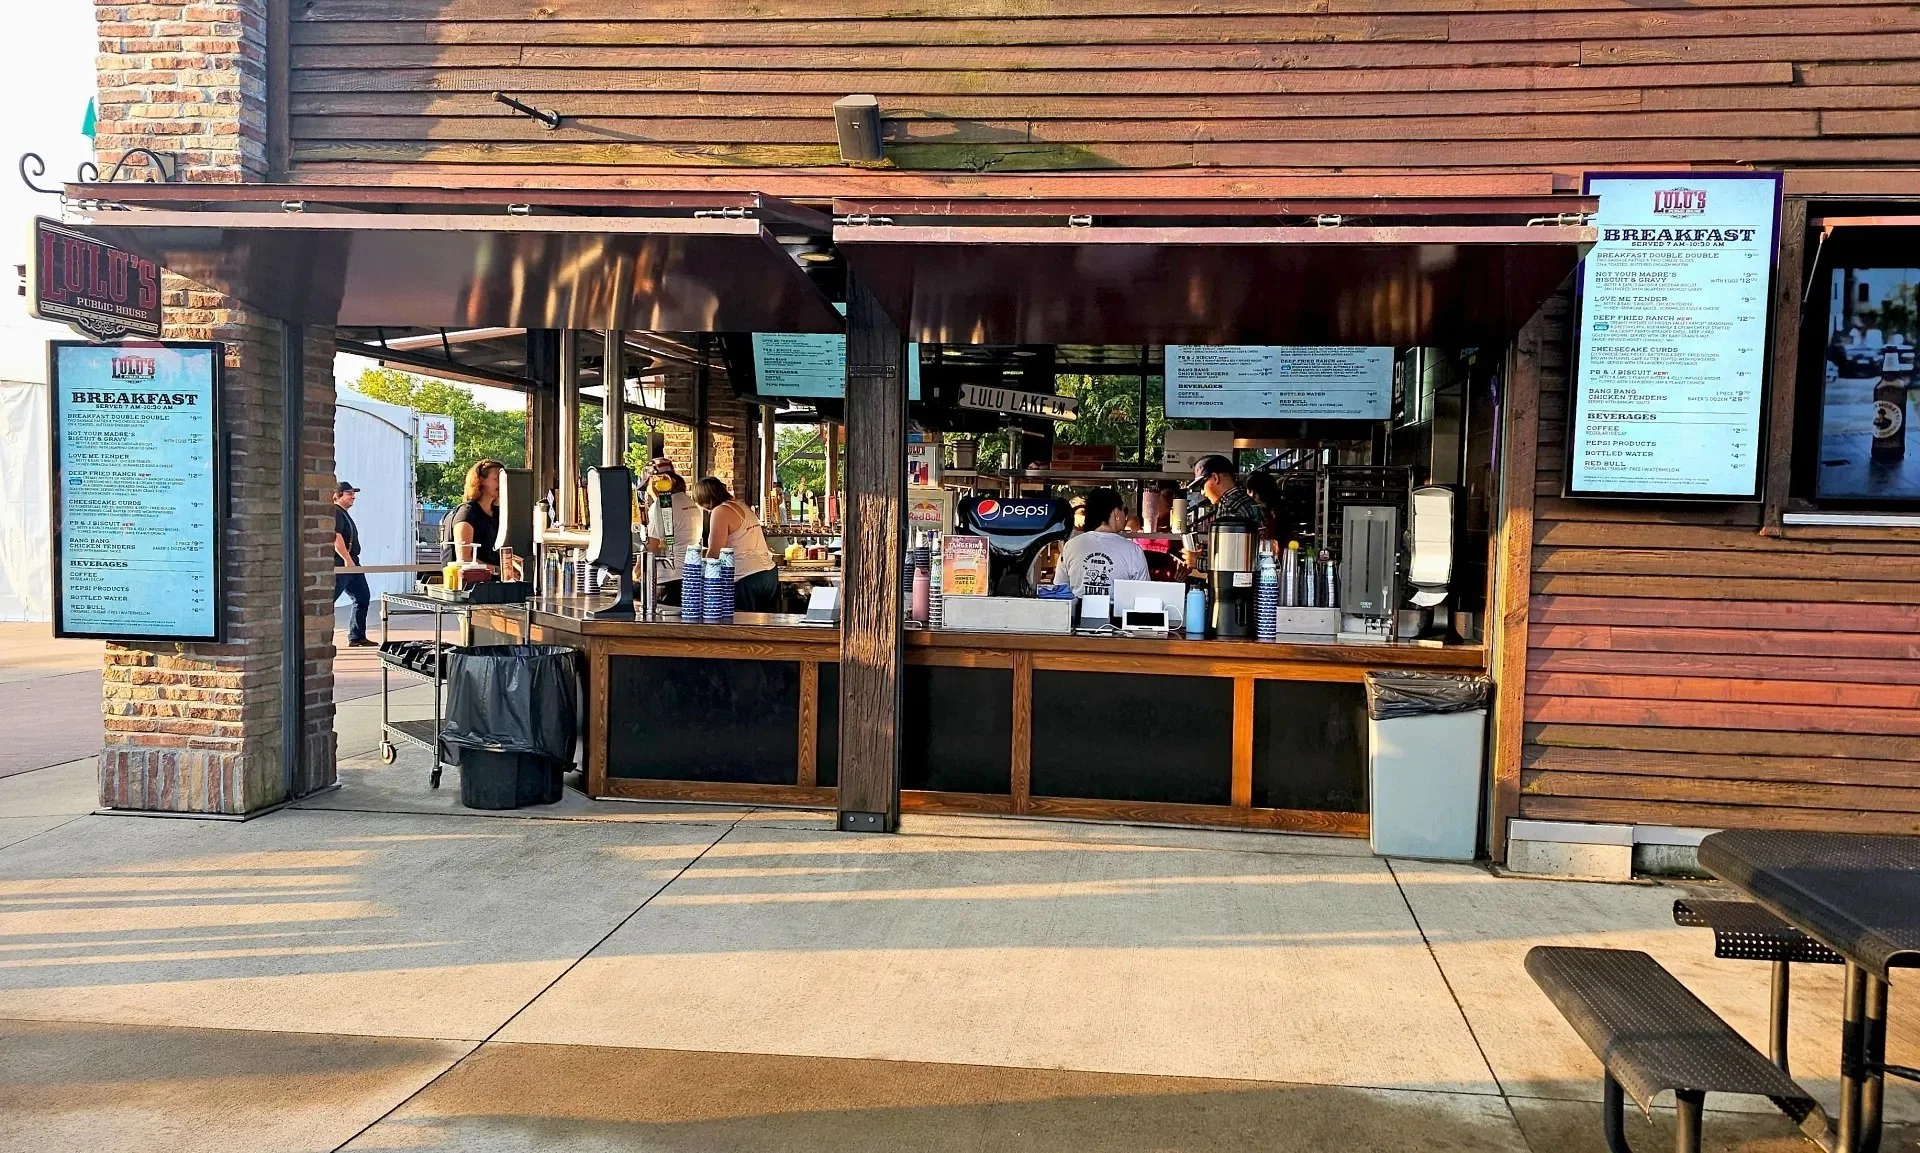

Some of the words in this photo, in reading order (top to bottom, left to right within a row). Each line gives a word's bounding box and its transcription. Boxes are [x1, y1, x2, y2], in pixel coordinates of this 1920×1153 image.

[1654, 190, 1706, 213] LULU'S
[1604, 229, 1755, 242] BREAKFAST
[42, 232, 156, 309] LULU'S
[77, 297, 113, 312] PUBLIC
[116, 306, 147, 318] HOUSE
[112, 358, 155, 378] LULU'S
[72, 392, 198, 405] BREAKFAST
[970, 388, 1004, 408] LULU
[1011, 393, 1048, 414] LAKE
[908, 512, 924, 521] Red
[925, 513, 941, 521] Bull
[1003, 504, 1048, 518] pepsi
